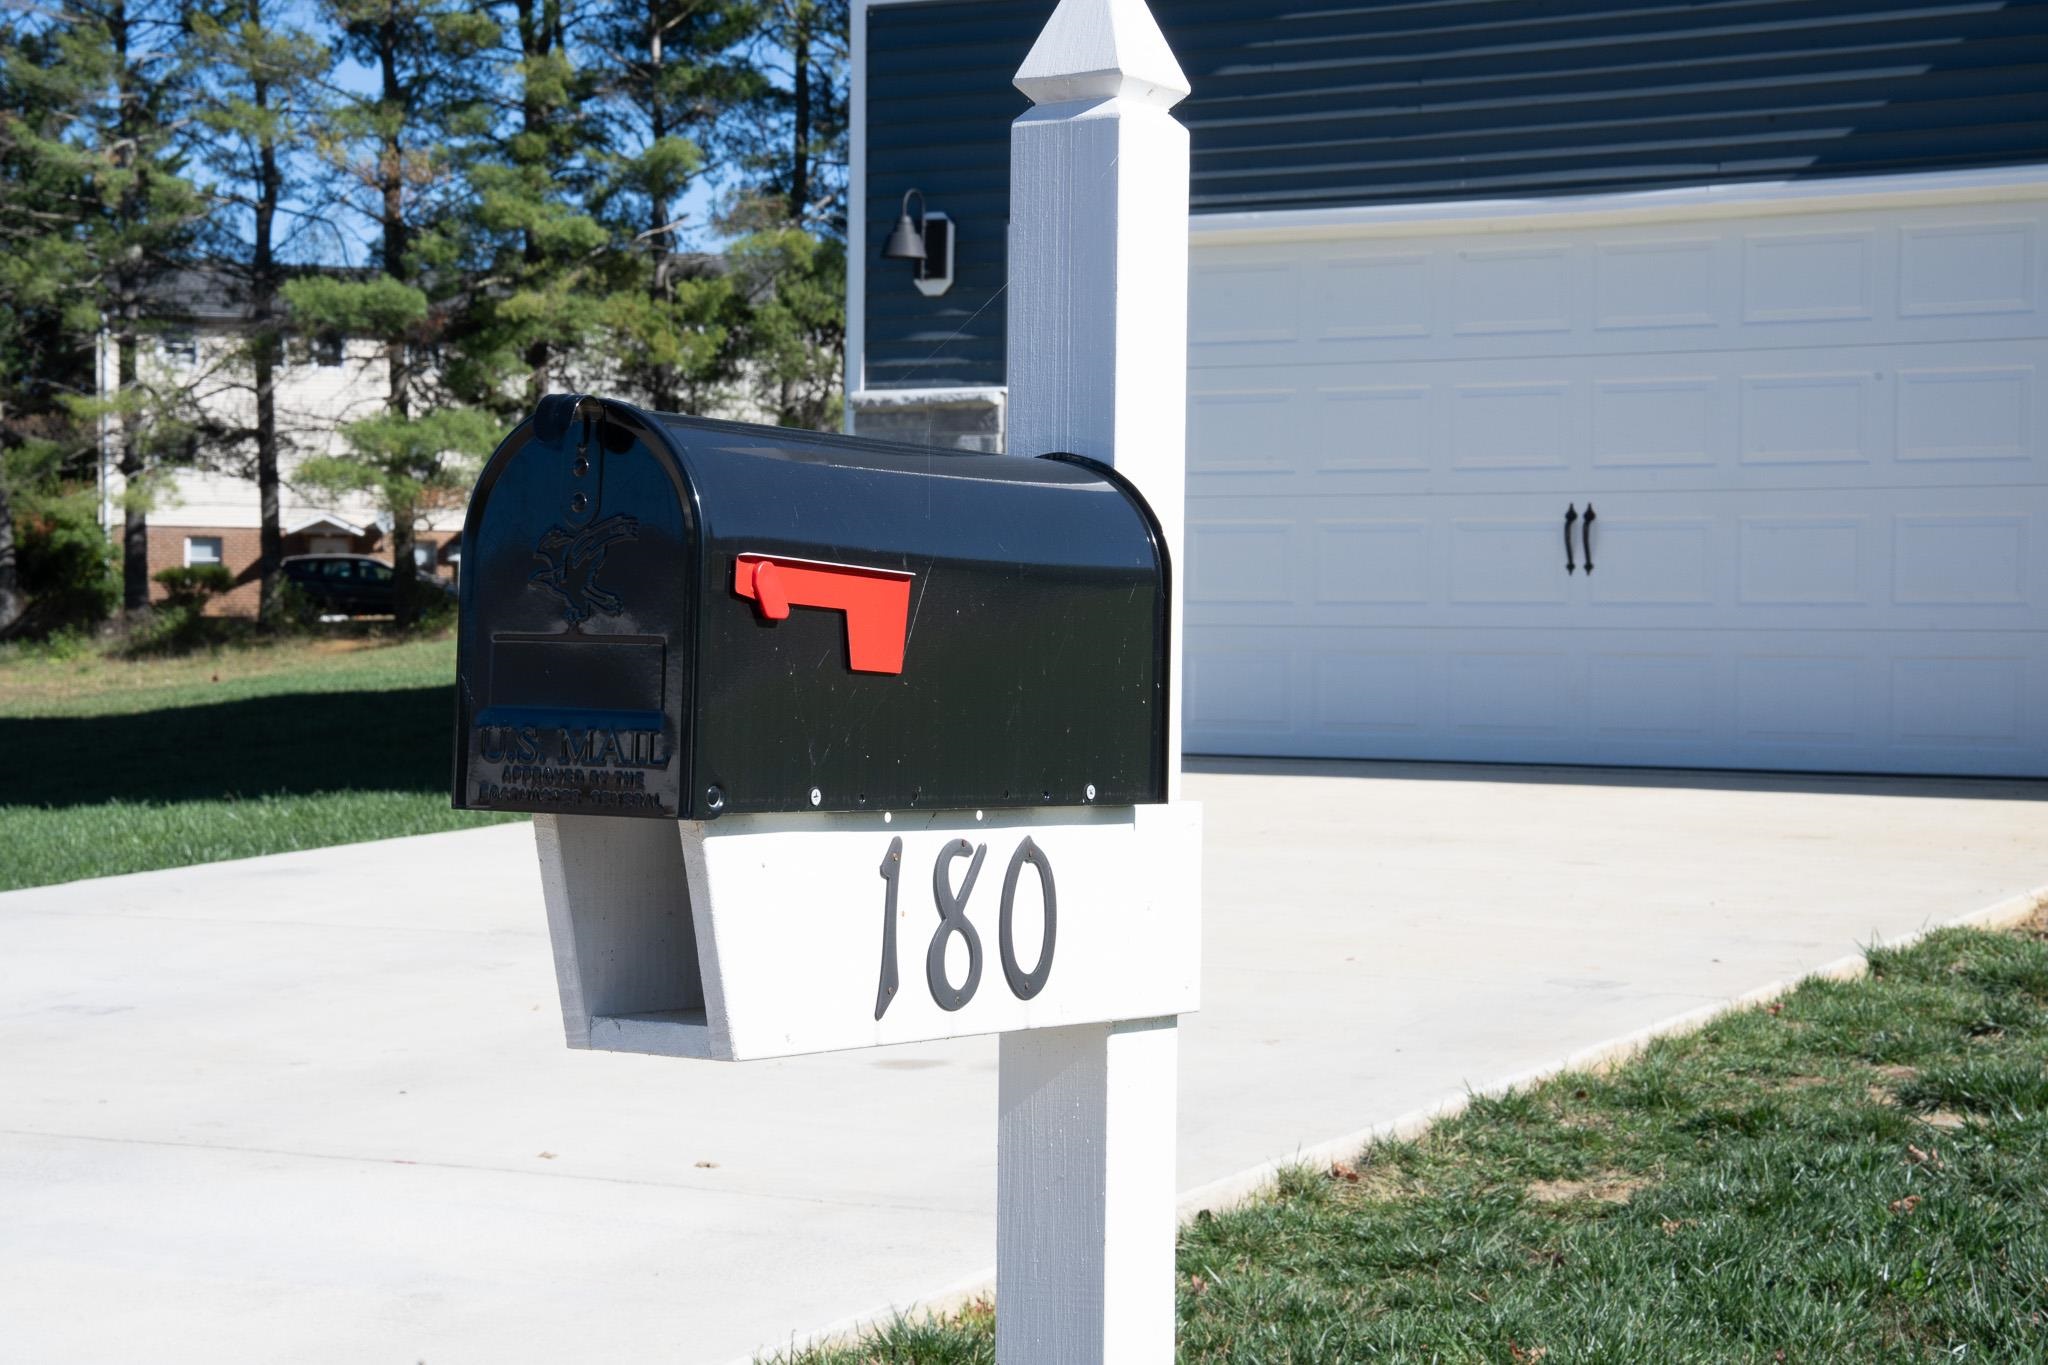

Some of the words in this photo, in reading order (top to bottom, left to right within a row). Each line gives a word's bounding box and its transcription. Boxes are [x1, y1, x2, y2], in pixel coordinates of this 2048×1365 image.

[480, 726, 545, 764] U.S.
[556, 727, 672, 770] MAIL
[501, 765, 585, 787] APPROVED
[616, 770, 646, 790] THE
[874, 835, 1057, 1021] 180
